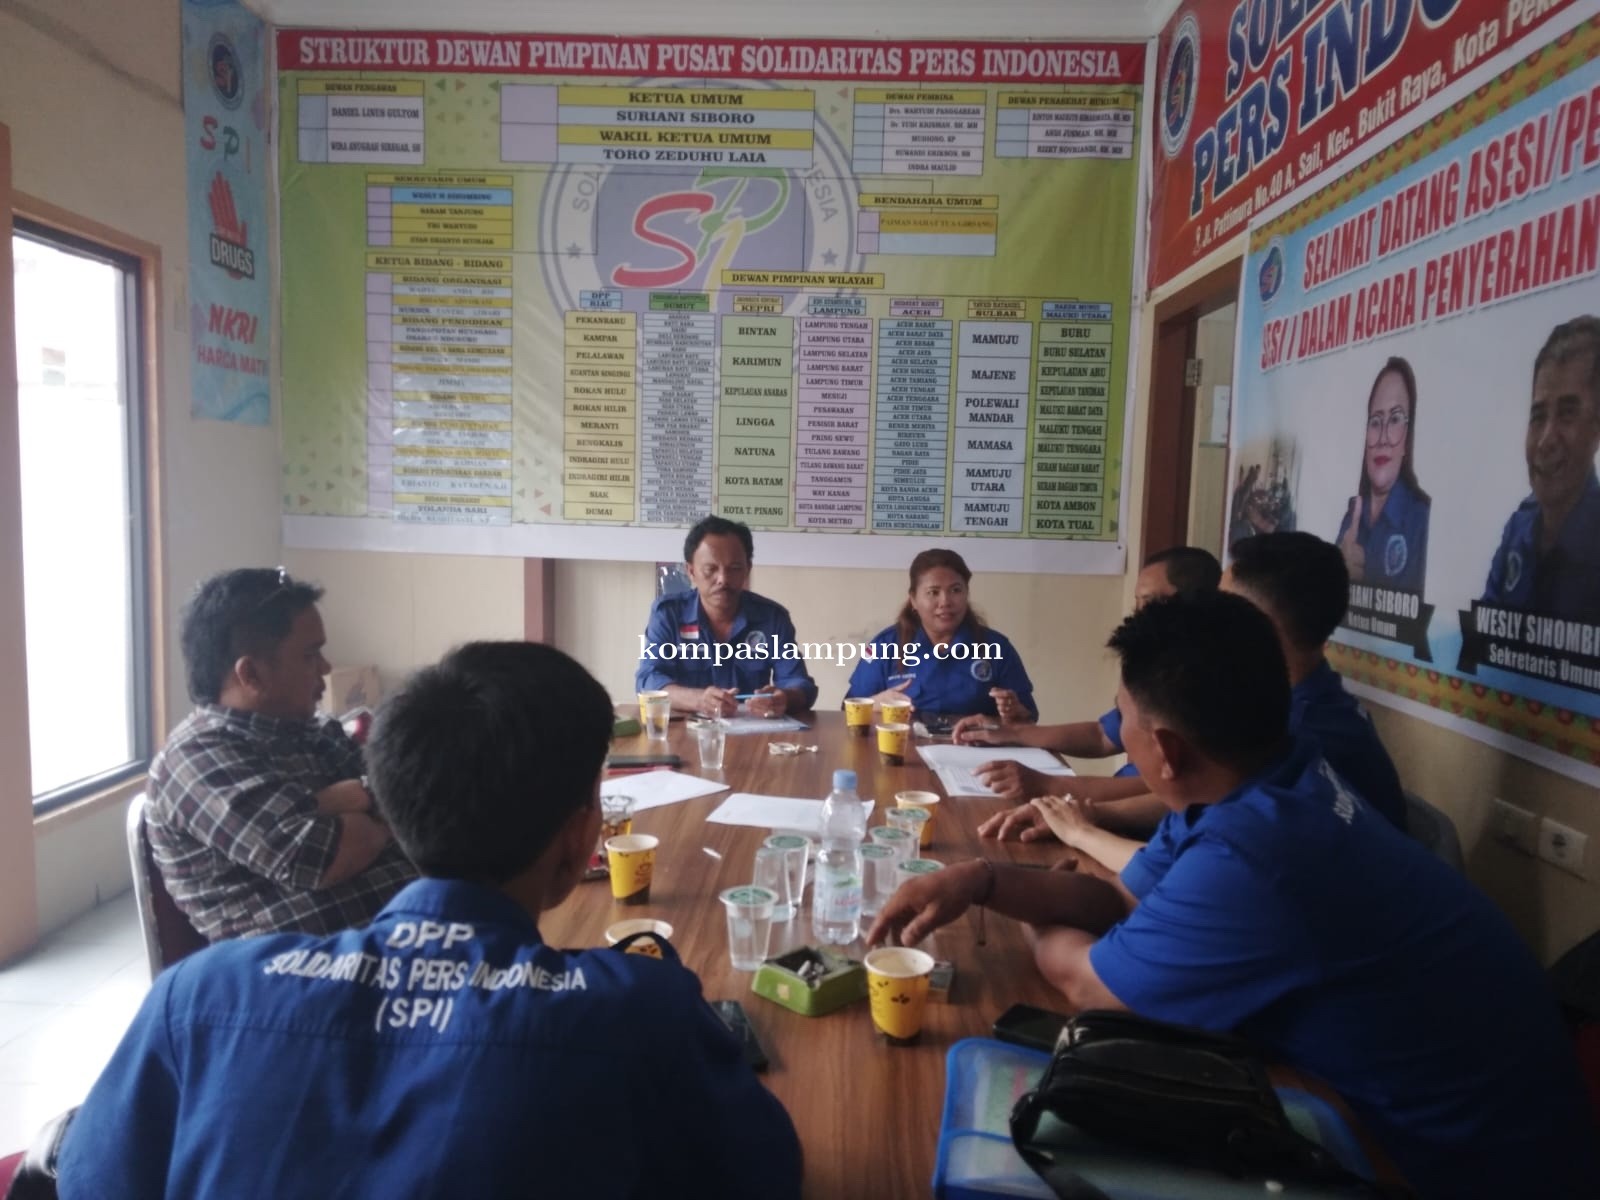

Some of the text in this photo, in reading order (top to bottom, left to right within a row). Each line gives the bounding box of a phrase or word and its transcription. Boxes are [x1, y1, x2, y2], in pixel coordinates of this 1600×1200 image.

[299, 36, 1121, 78] STRUKTUR DEWAN PIMPINAN PUSAT SOLIDARITAS PERS INDONESIA
[628, 92, 744, 106] KETUA UMUM
[1298, 142, 1324, 179] Sail,
[1327, 125, 1354, 161] Kec.
[1358, 94, 1397, 140] Bukit
[1399, 59, 1447, 110] Raya,
[1453, 18, 1500, 73] Kota
[616, 110, 756, 124] SURIANI SIBORO
[599, 130, 772, 145] WAKIL KETUA UMUM
[1190, 45, 1293, 220] PERS
[603, 148, 767, 164] TORO ZEDUHU LAIA
[874, 196, 983, 206] BENDAHARA UMUM
[1303, 207, 1377, 290] SELAMAT
[1378, 158, 1461, 256] DATANG
[212, 238, 253, 275] DRUGS
[375, 256, 411, 266] KETUA
[414, 257, 454, 268] BIDANG
[464, 259, 504, 269] BIDANG
[732, 273, 874, 286] DEWAN PIMPINAN WILAYAH
[1297, 292, 1351, 359] DALAM
[1353, 268, 1418, 341] ACARA
[1421, 193, 1600, 321] PENYERAHAN
[208, 303, 258, 344] NKRI
[576, 316, 626, 325] PEKANBARU
[738, 327, 776, 336] BINTAN
[1061, 328, 1091, 338] BURU
[583, 334, 618, 342] KAMPAR
[972, 334, 1019, 345] MAMUJU
[576, 352, 624, 360] PELALAWAN
[803, 350, 836, 358] LAMPUNG
[1043, 346, 1106, 358] BURU SELATAN
[197, 345, 238, 371] HARGA
[732, 356, 782, 367] KARIMUN
[806, 364, 840, 372] LAMPUNG
[1041, 366, 1106, 378] KEPULAUAN ARU
[971, 370, 1016, 380] MAJENE
[806, 378, 839, 386] LAMPUNG
[574, 386, 602, 394] ROKAN
[572, 404, 602, 412] ROKAN
[965, 398, 1020, 408] POLEWALI
[736, 417, 775, 427] LINGGA
[968, 412, 1014, 424] MANDAR
[580, 422, 619, 430] MERANTI
[1038, 424, 1102, 436] MALUKU TENGAH
[967, 440, 1014, 450] MAMASA
[1066, 444, 1102, 455] TENGGARA
[734, 448, 776, 457] NATUNA
[966, 468, 1012, 479] MAMUJU
[724, 476, 784, 486] KOTA BATAM
[970, 482, 1006, 492] UTARA
[589, 490, 609, 498] SIAK
[722, 506, 744, 514] KOTA
[754, 507, 783, 516] PINANG
[964, 503, 1010, 512] MAMUJU
[1036, 500, 1097, 512] KOTA AMBON
[586, 508, 613, 516] DUMAI
[964, 516, 1008, 527] TENGAH
[1036, 518, 1094, 530] KOTA TUAL
[1375, 588, 1420, 620] SIBORO
[1476, 605, 1523, 640] WESLY
[1489, 643, 1557, 678] Sekretaris
[386, 920, 477, 950] DPP
[264, 951, 588, 993] SOLIDARITAS PERS INDONESIA
[374, 996, 455, 1033] (SPI)
